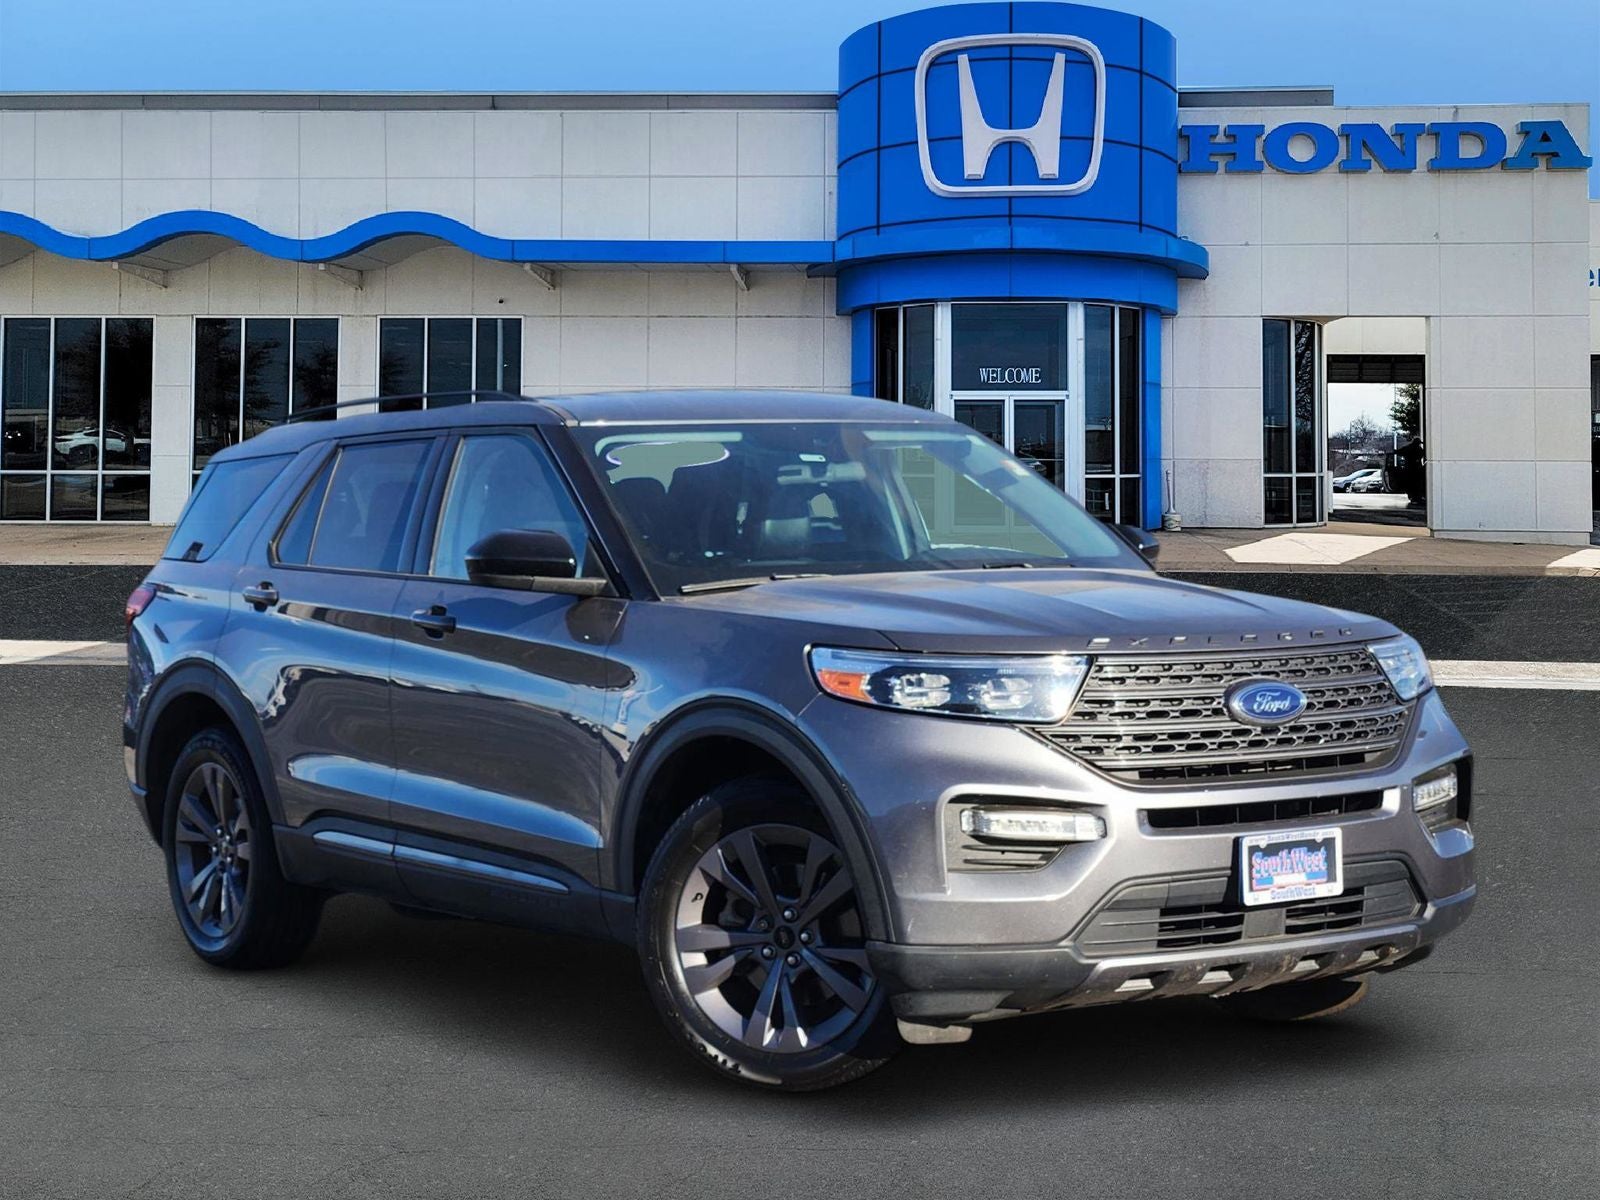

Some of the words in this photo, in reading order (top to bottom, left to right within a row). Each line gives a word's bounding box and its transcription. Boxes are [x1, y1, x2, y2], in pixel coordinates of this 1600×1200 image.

[1178, 120, 1593, 174] HONDA
[979, 367, 1042, 384] WELCOME
[1087, 627, 1353, 649] EXPLORER
[1252, 691, 1292, 713] Ford
[1251, 846, 1328, 879] SouthWest
